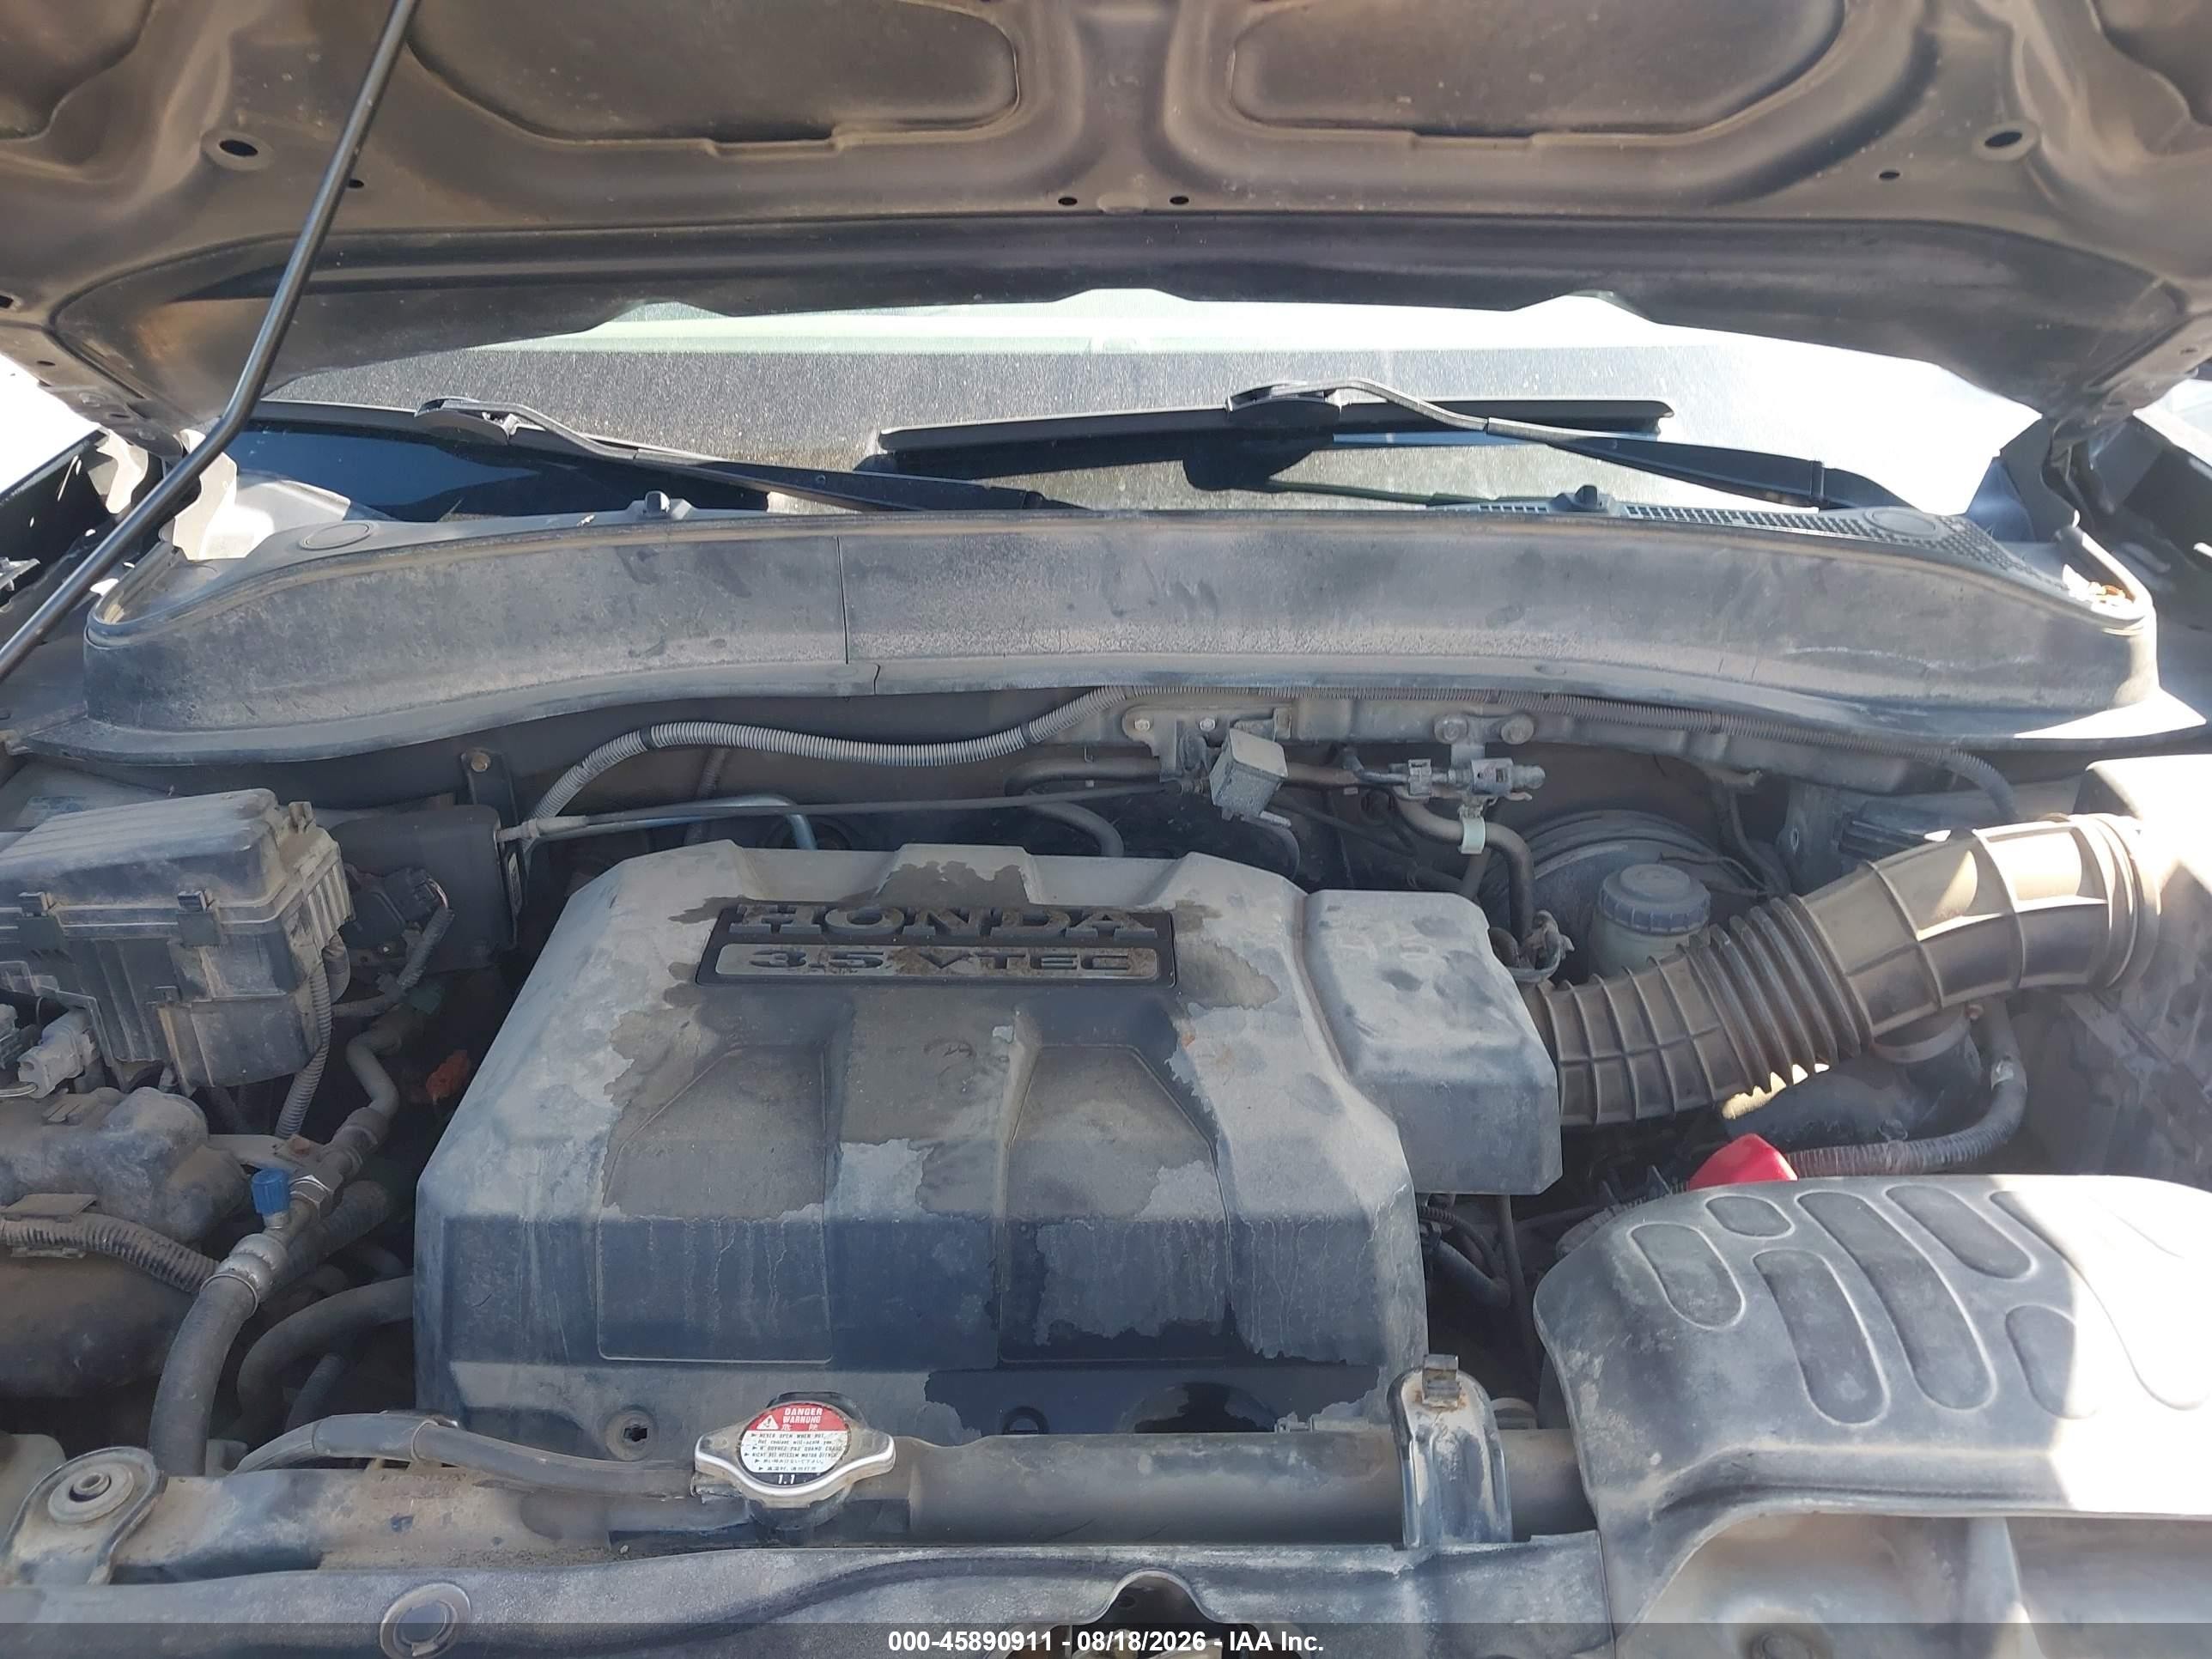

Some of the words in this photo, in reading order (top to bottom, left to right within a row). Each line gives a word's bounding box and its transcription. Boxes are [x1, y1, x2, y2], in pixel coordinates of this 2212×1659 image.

[730, 904, 1158, 938] HONDA
[749, 950, 884, 969] 3.5
[917, 951, 1129, 970] VTEC
[784, 1407, 823, 1416] DANGER
[782, 1415, 822, 1424] WARNUNG
[778, 1474, 795, 1484] 1.1
